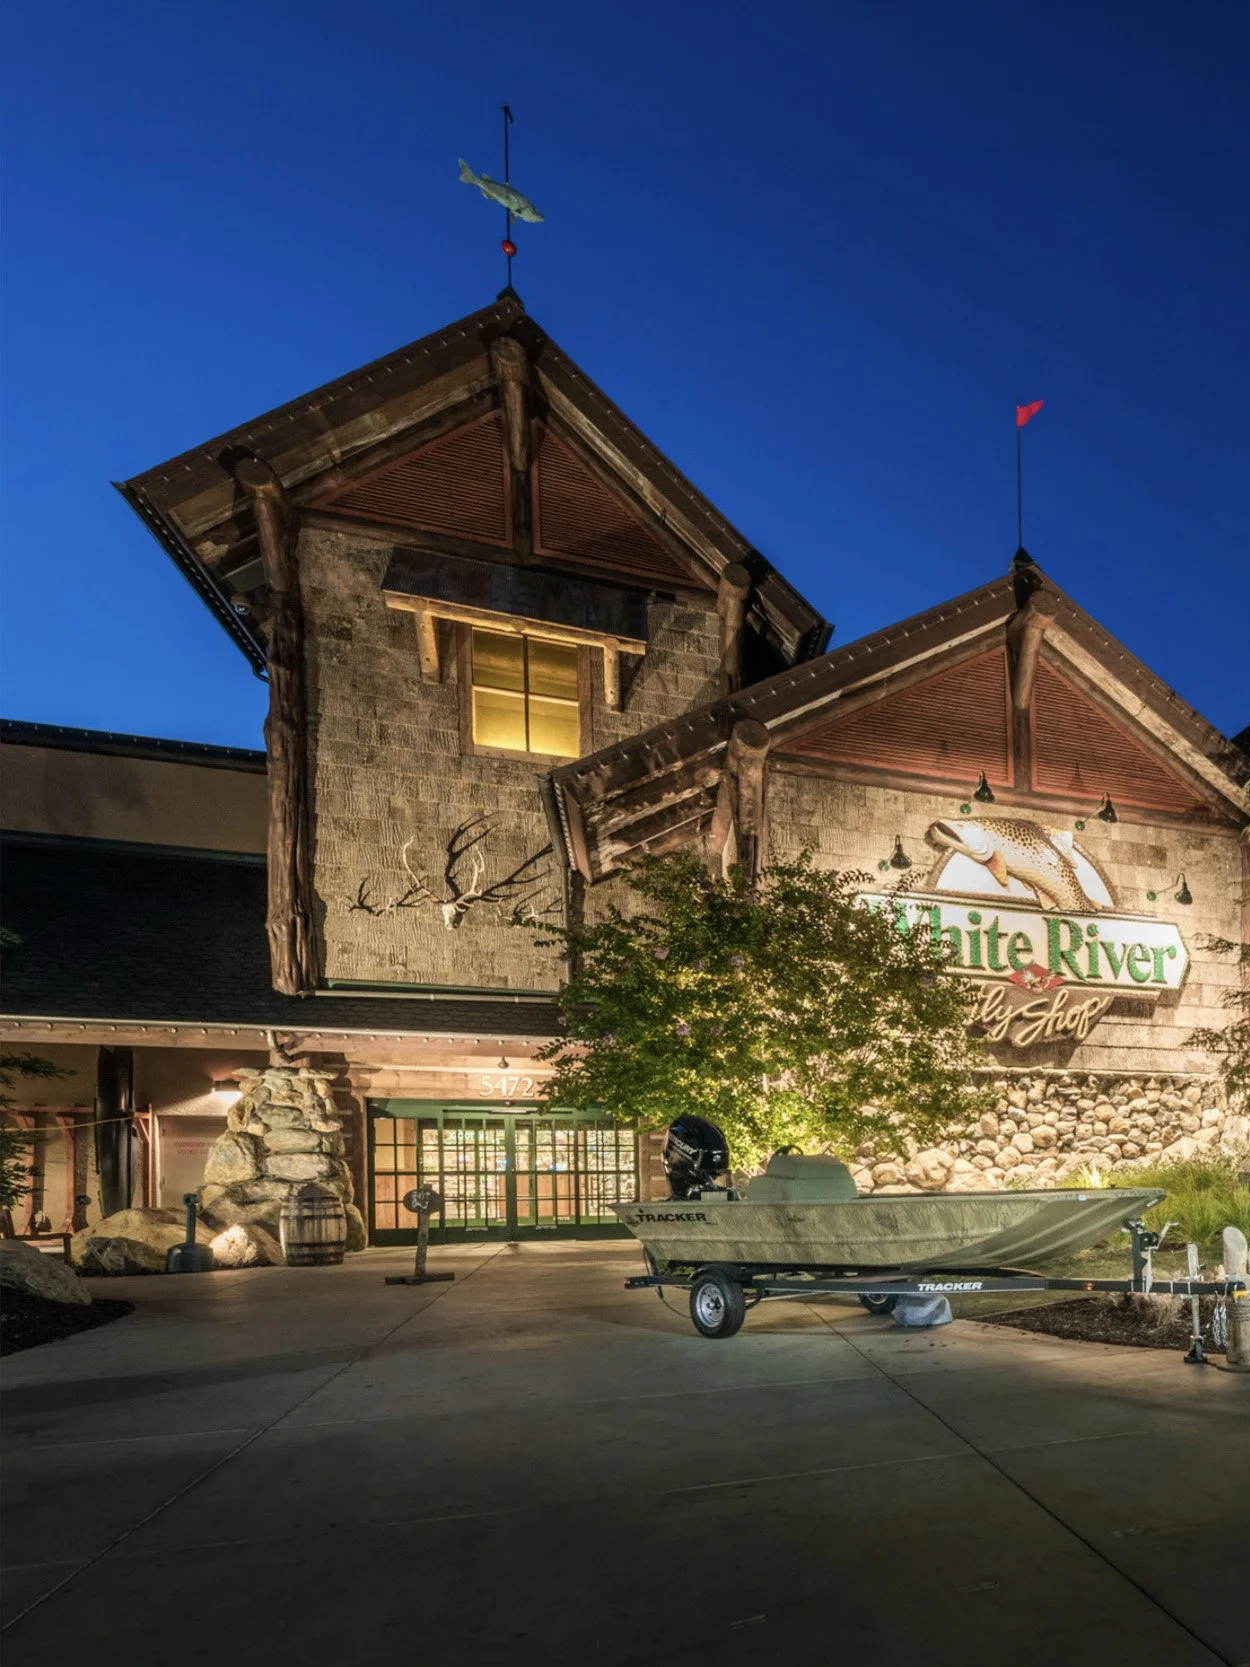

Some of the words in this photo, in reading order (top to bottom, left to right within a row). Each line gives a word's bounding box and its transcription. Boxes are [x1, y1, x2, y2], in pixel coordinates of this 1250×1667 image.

[1042, 917, 1177, 984] River
[1011, 989, 1110, 1048] Shop
[480, 1075, 535, 1098] 5472
[635, 1212, 707, 1223] TRACKER
[917, 1281, 983, 1292] TRACKER
